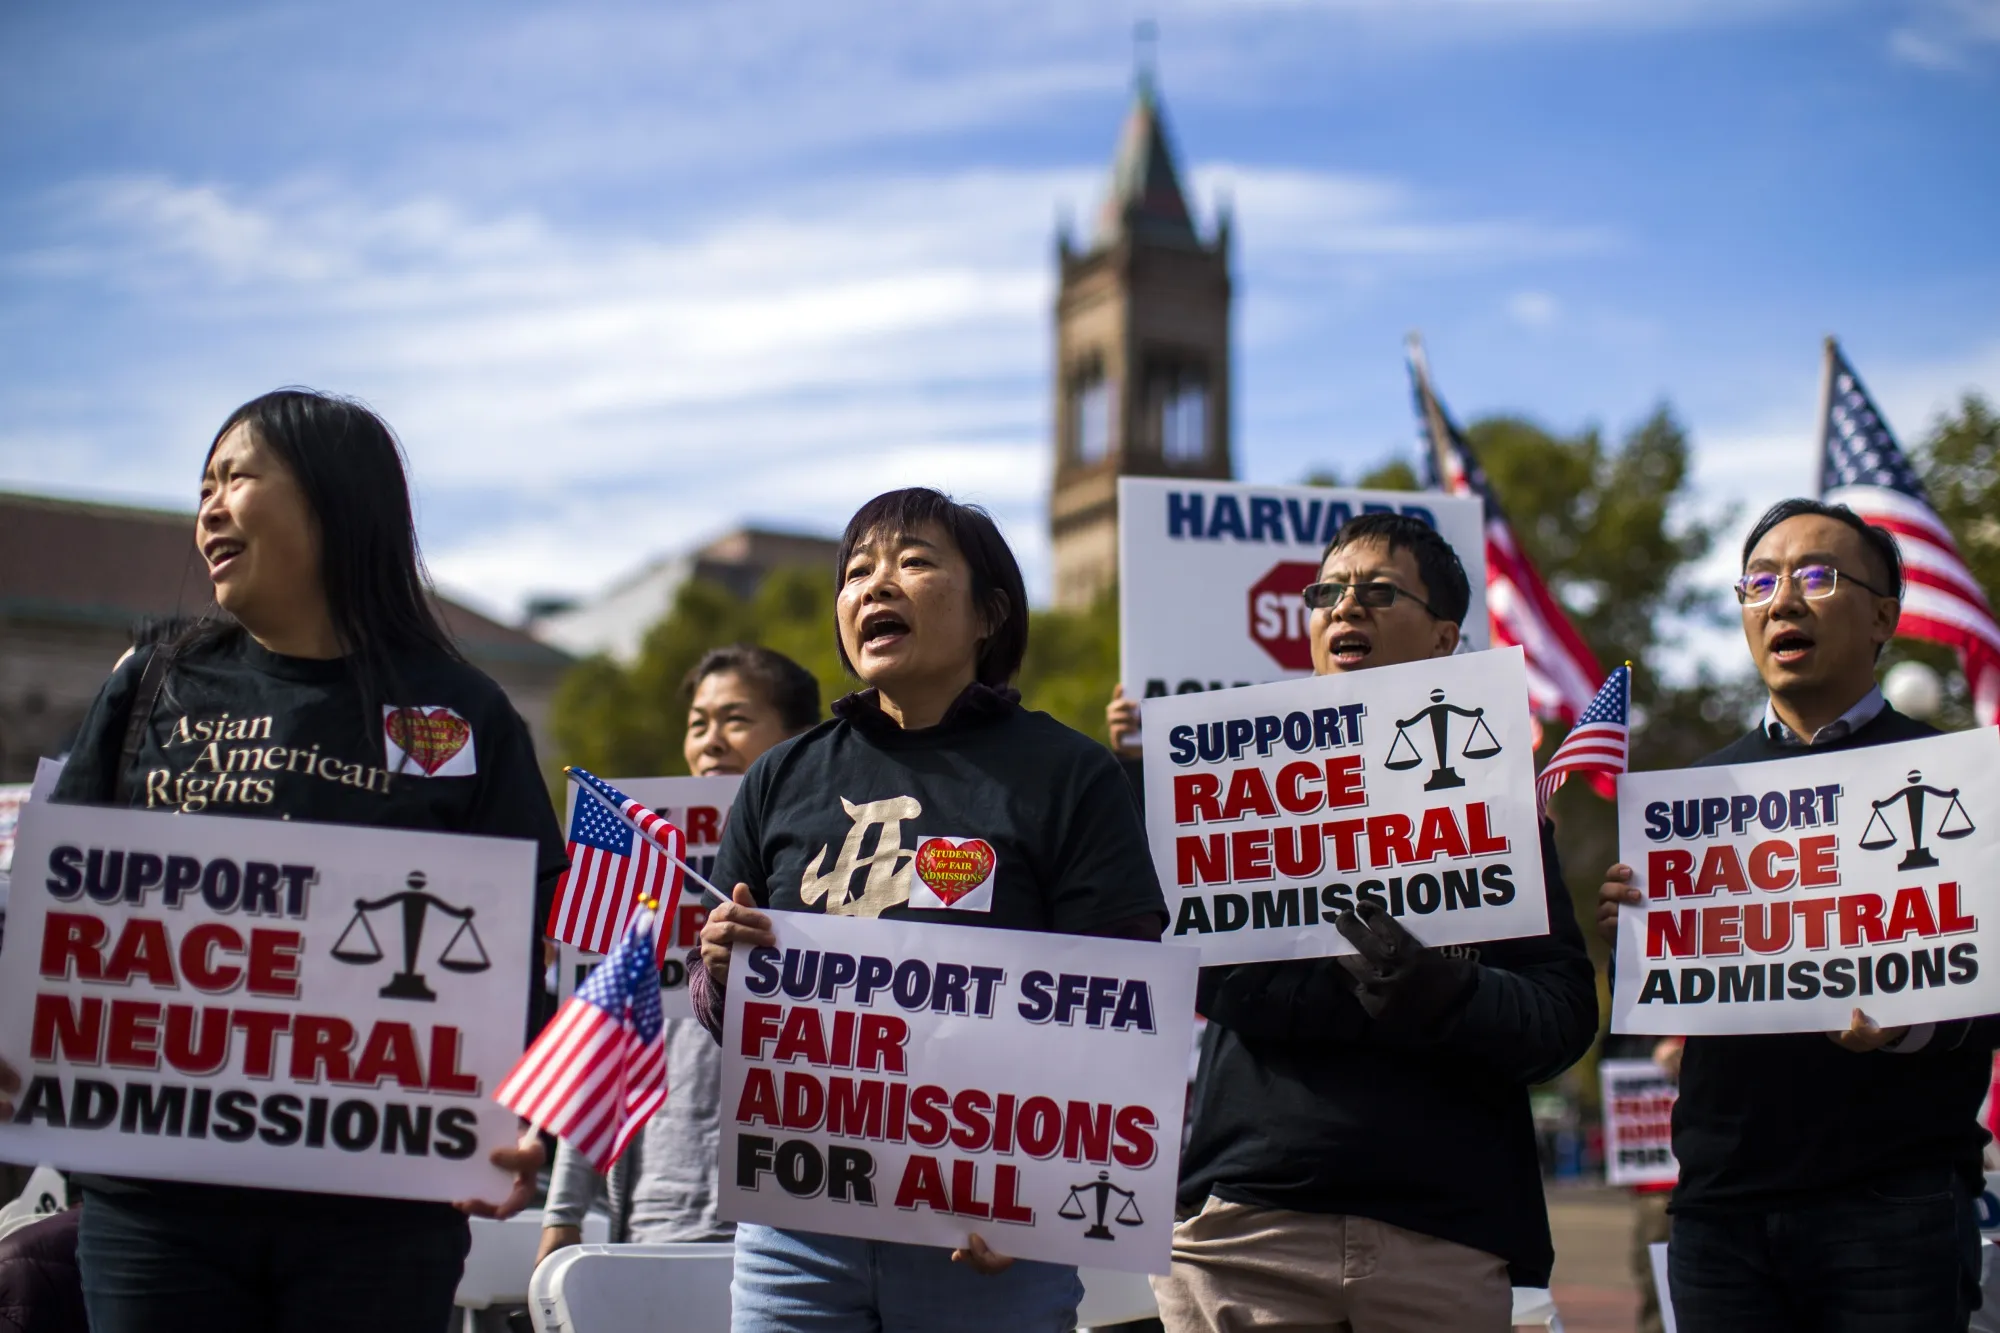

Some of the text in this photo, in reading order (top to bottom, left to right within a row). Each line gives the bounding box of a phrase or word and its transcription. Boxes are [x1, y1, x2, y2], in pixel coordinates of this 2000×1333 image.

[1167, 492, 1437, 543] HARVA
[161, 712, 274, 748] Asian
[1169, 703, 1367, 767] SUPPORT
[145, 768, 275, 813] Rights
[187, 742, 390, 794] American
[1173, 755, 1369, 827] RACE
[1176, 801, 1512, 889] NEUTRAL
[1644, 784, 1844, 843] SUPPORT
[46, 845, 319, 921] SUPPORT
[923, 872, 983, 882] ADMISSIONS
[929, 850, 982, 859] STUDENTS
[935, 860, 973, 871] for FAIR
[1647, 834, 1842, 902] RACE
[1173, 863, 1516, 937] ADMISSIONS
[1646, 881, 1979, 961] NEUTRAL
[39, 911, 305, 1001] RACE
[744, 945, 1007, 1019] SUPPORT
[1017, 970, 1157, 1035] SFFA
[1637, 942, 1979, 1005] ADMISSIONS
[30, 993, 481, 1099] NEUTRAL
[740, 1001, 911, 1077] FAIR
[13, 1074, 479, 1162] ADMISSIONS
[735, 1067, 1160, 1171] ADMISSIONS
[736, 1133, 1036, 1228] FOR ALL
